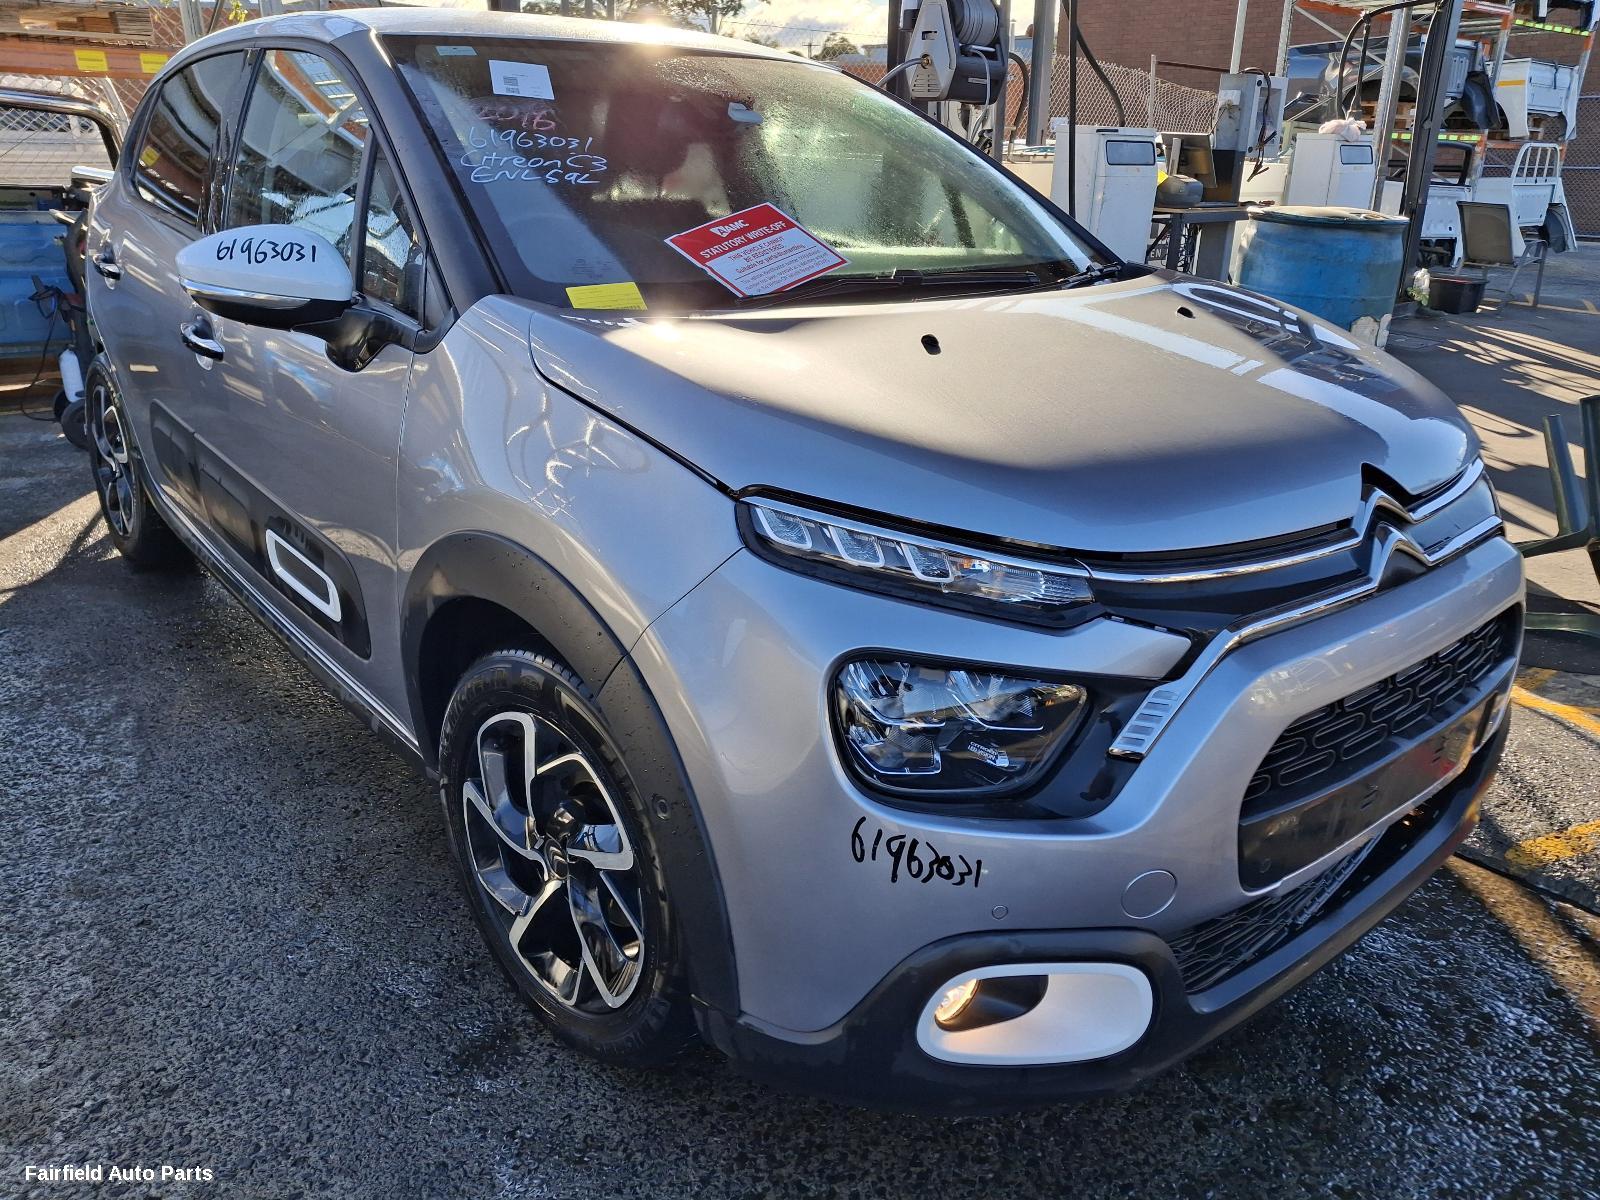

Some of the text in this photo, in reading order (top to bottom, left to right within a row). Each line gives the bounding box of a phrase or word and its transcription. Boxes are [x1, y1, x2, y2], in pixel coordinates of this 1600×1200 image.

[469, 127, 593, 152] 61963031
[566, 153, 608, 172] C3
[216, 237, 317, 265] 61963031
[700, 221, 787, 259] STATUTORY WRITE-OFF
[851, 816, 982, 888] 61963031
